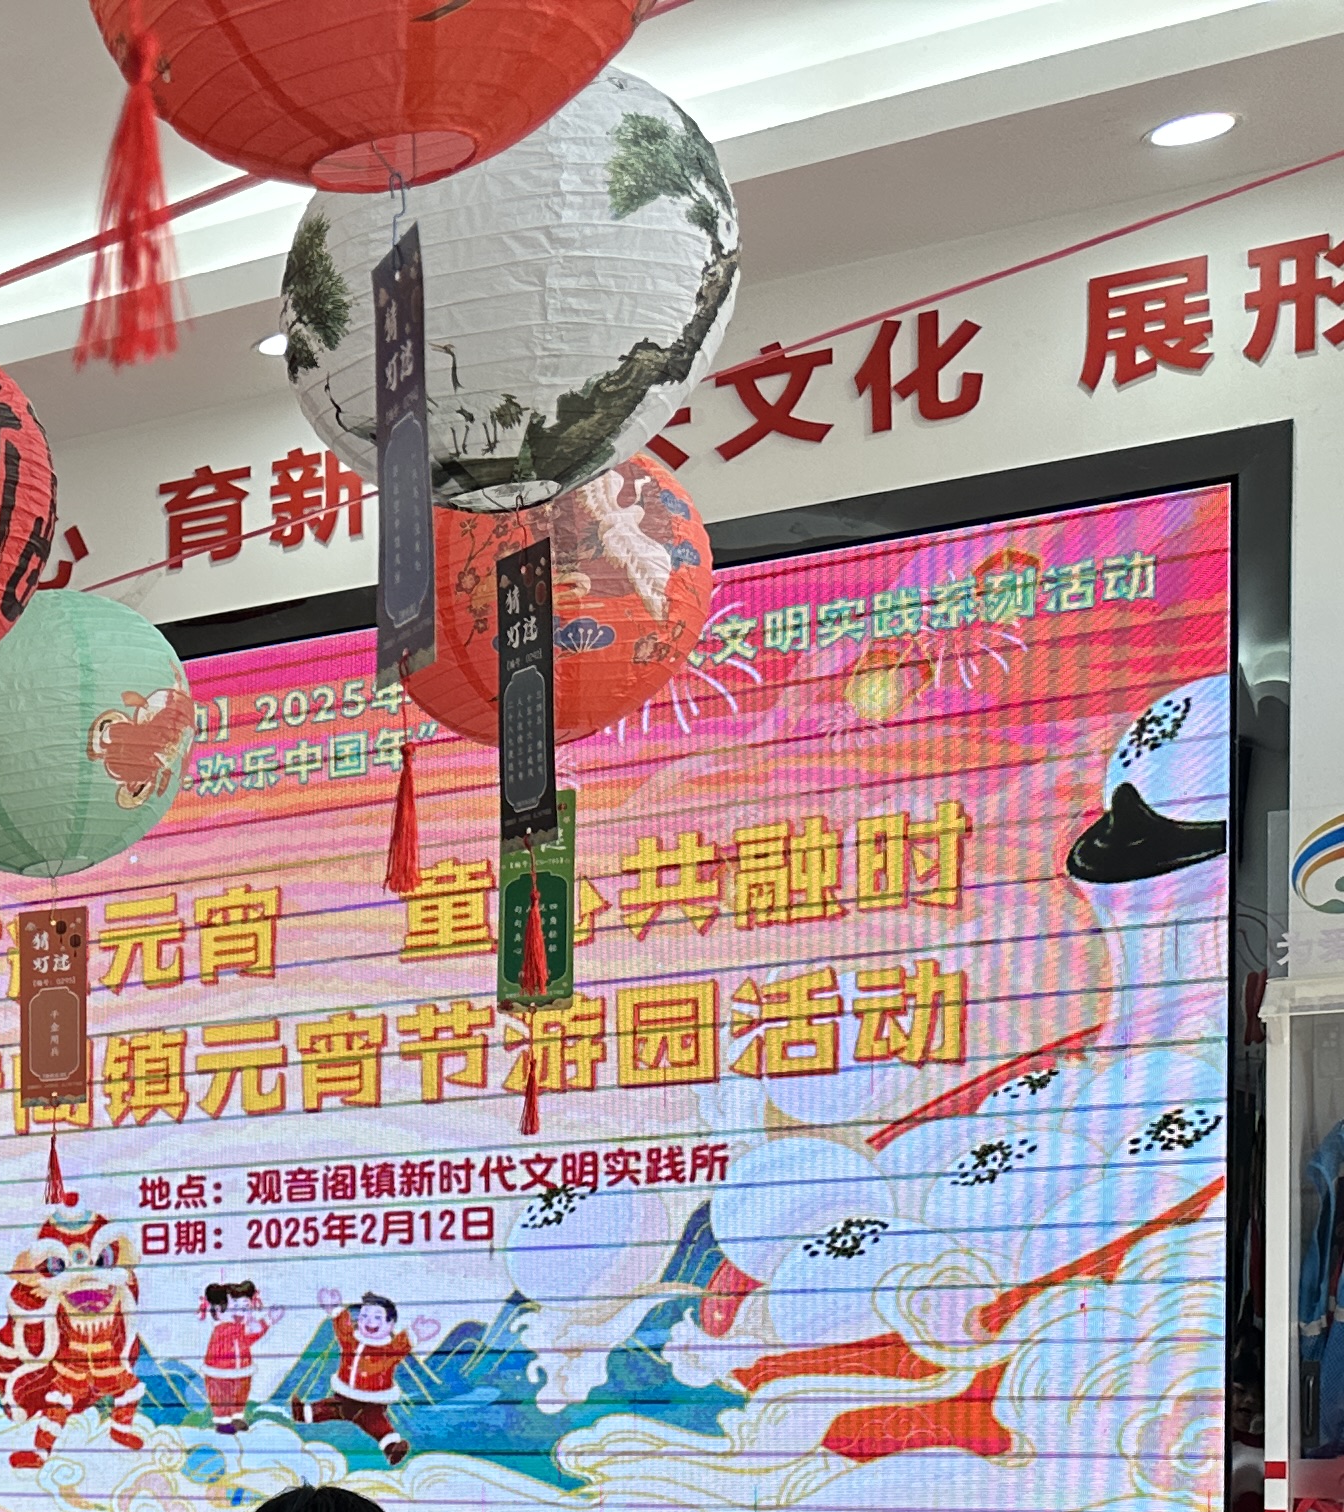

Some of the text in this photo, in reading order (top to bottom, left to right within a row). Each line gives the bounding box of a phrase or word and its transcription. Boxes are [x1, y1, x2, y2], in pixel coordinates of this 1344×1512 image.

[140, 1206, 495, 1256] 日期：2025年2月12日
